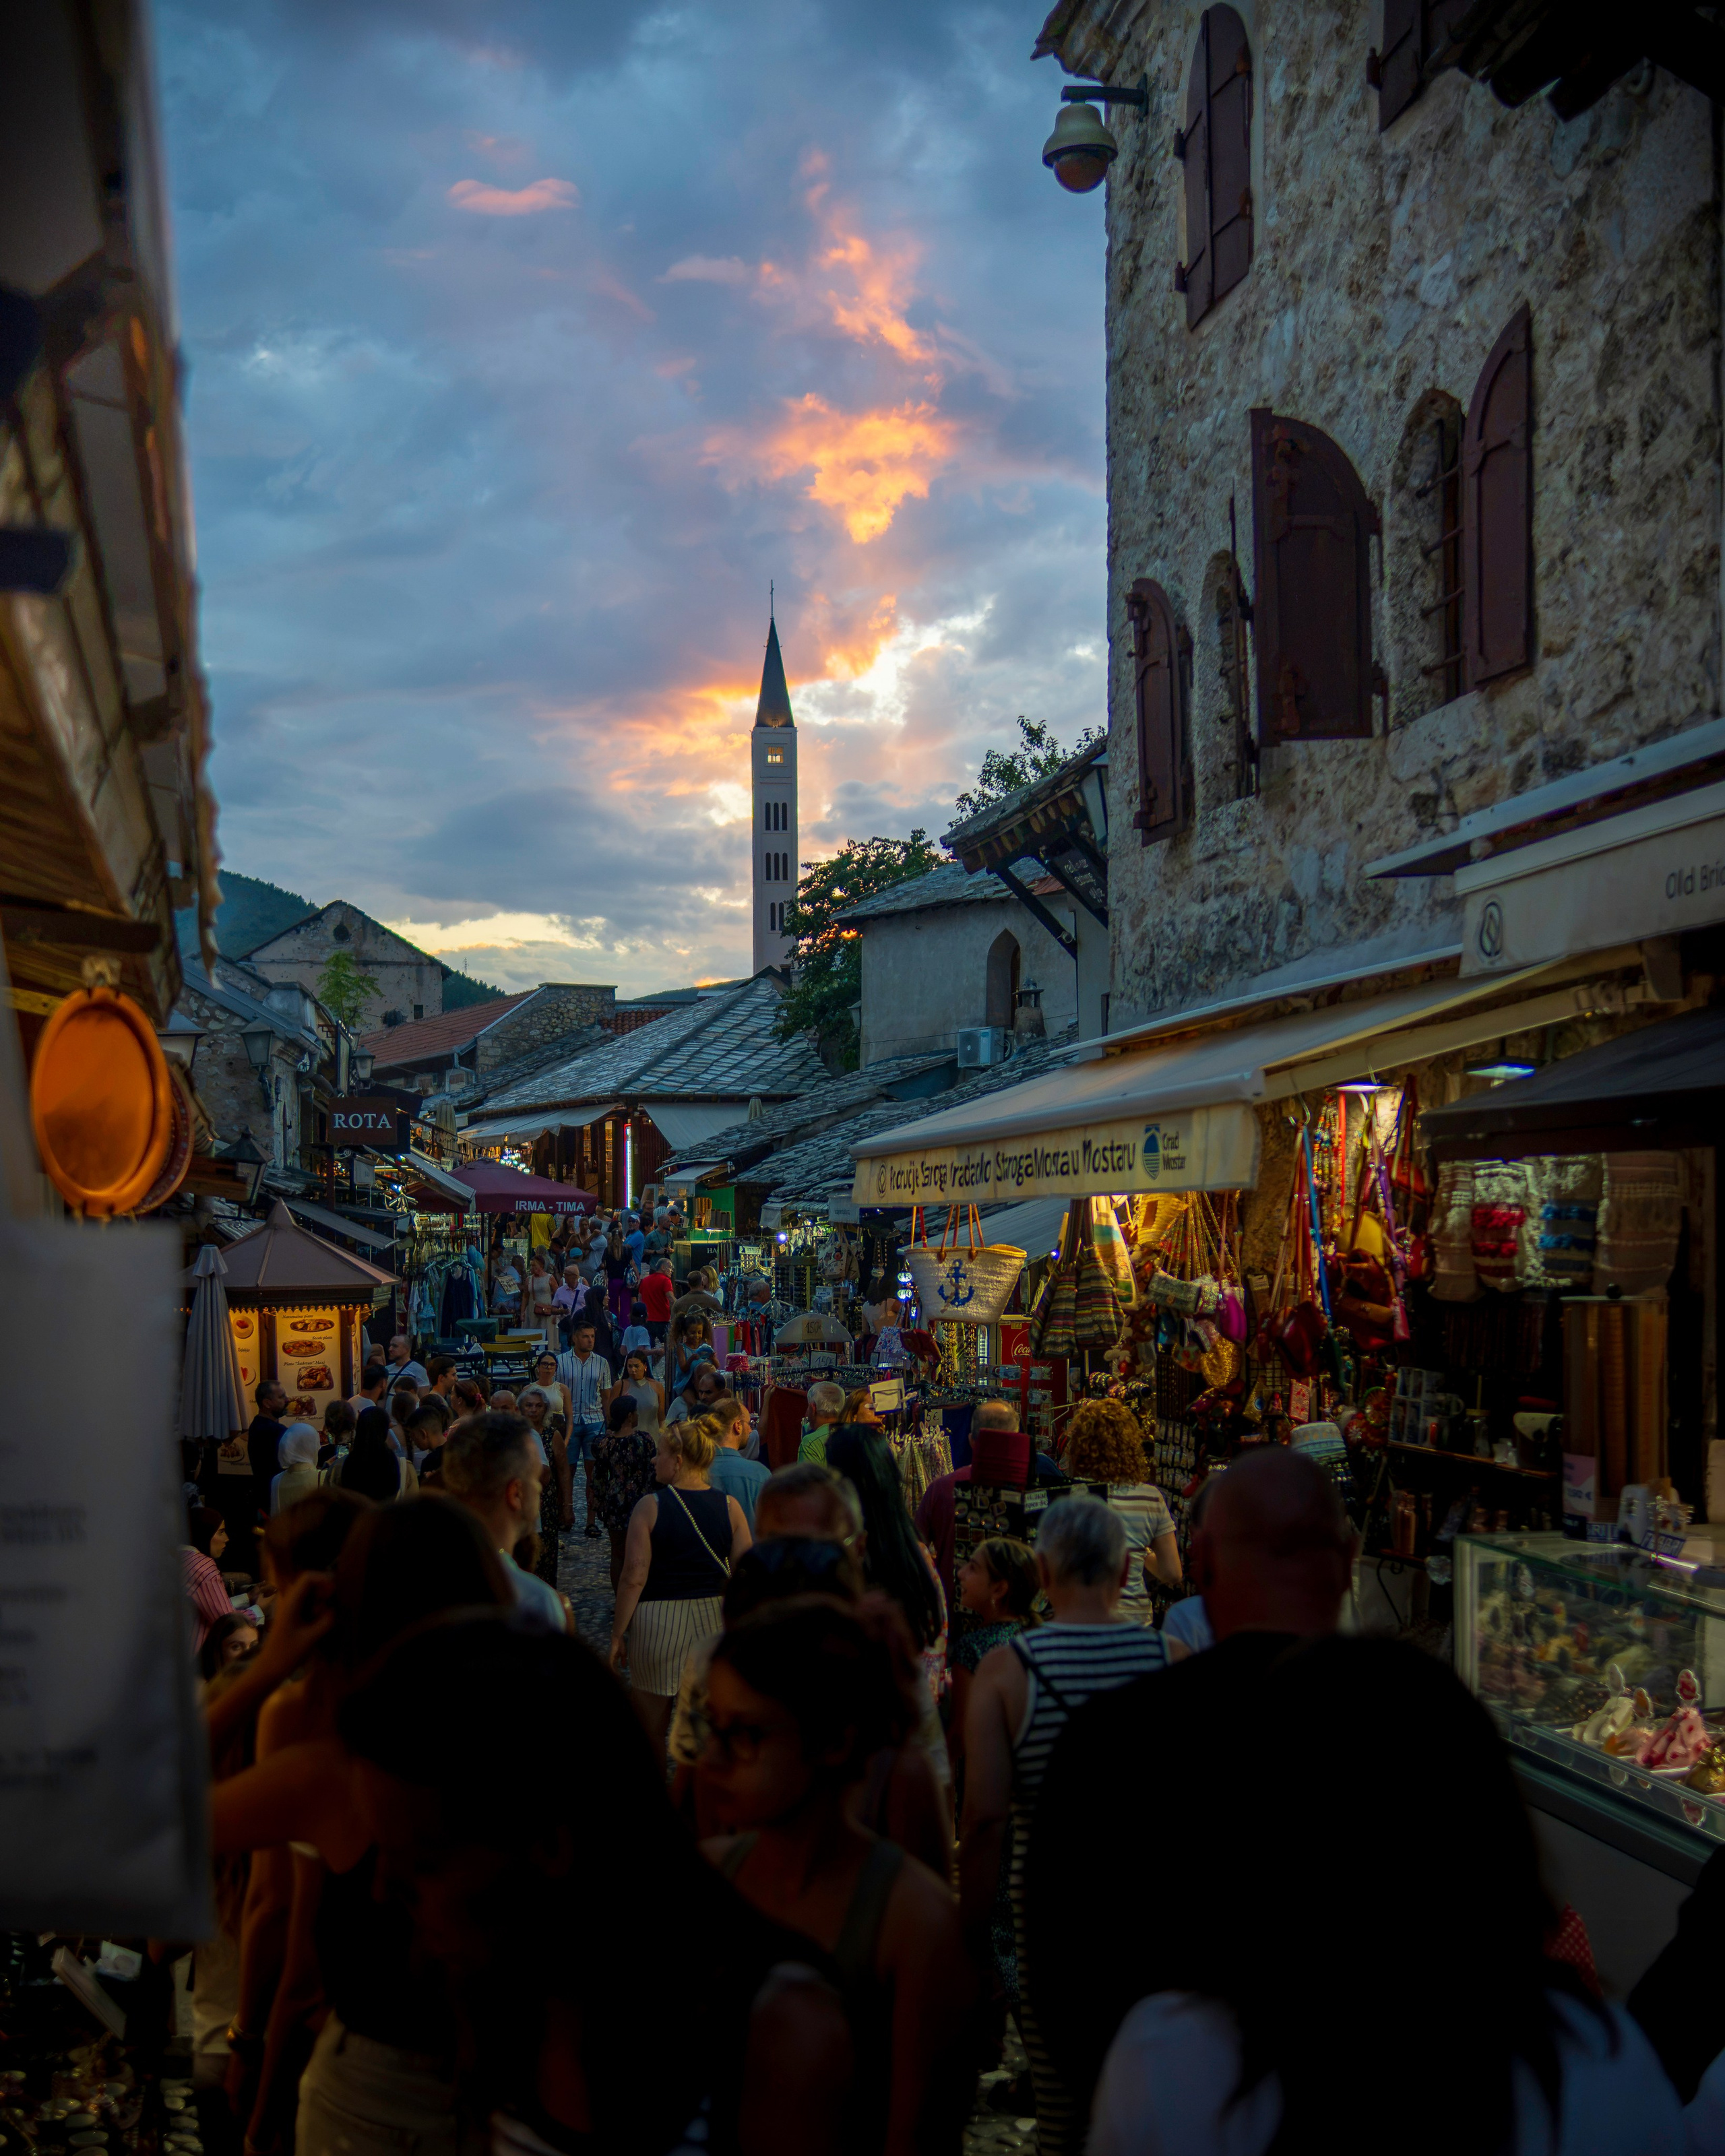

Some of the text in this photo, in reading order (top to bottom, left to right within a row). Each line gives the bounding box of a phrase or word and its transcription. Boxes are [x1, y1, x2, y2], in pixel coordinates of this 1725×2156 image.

[1666, 866, 1695, 899] Old
[333, 1113, 392, 1129] ROTA
[515, 1200, 546, 1211] IRMA
[556, 1201, 585, 1211] TIMA
